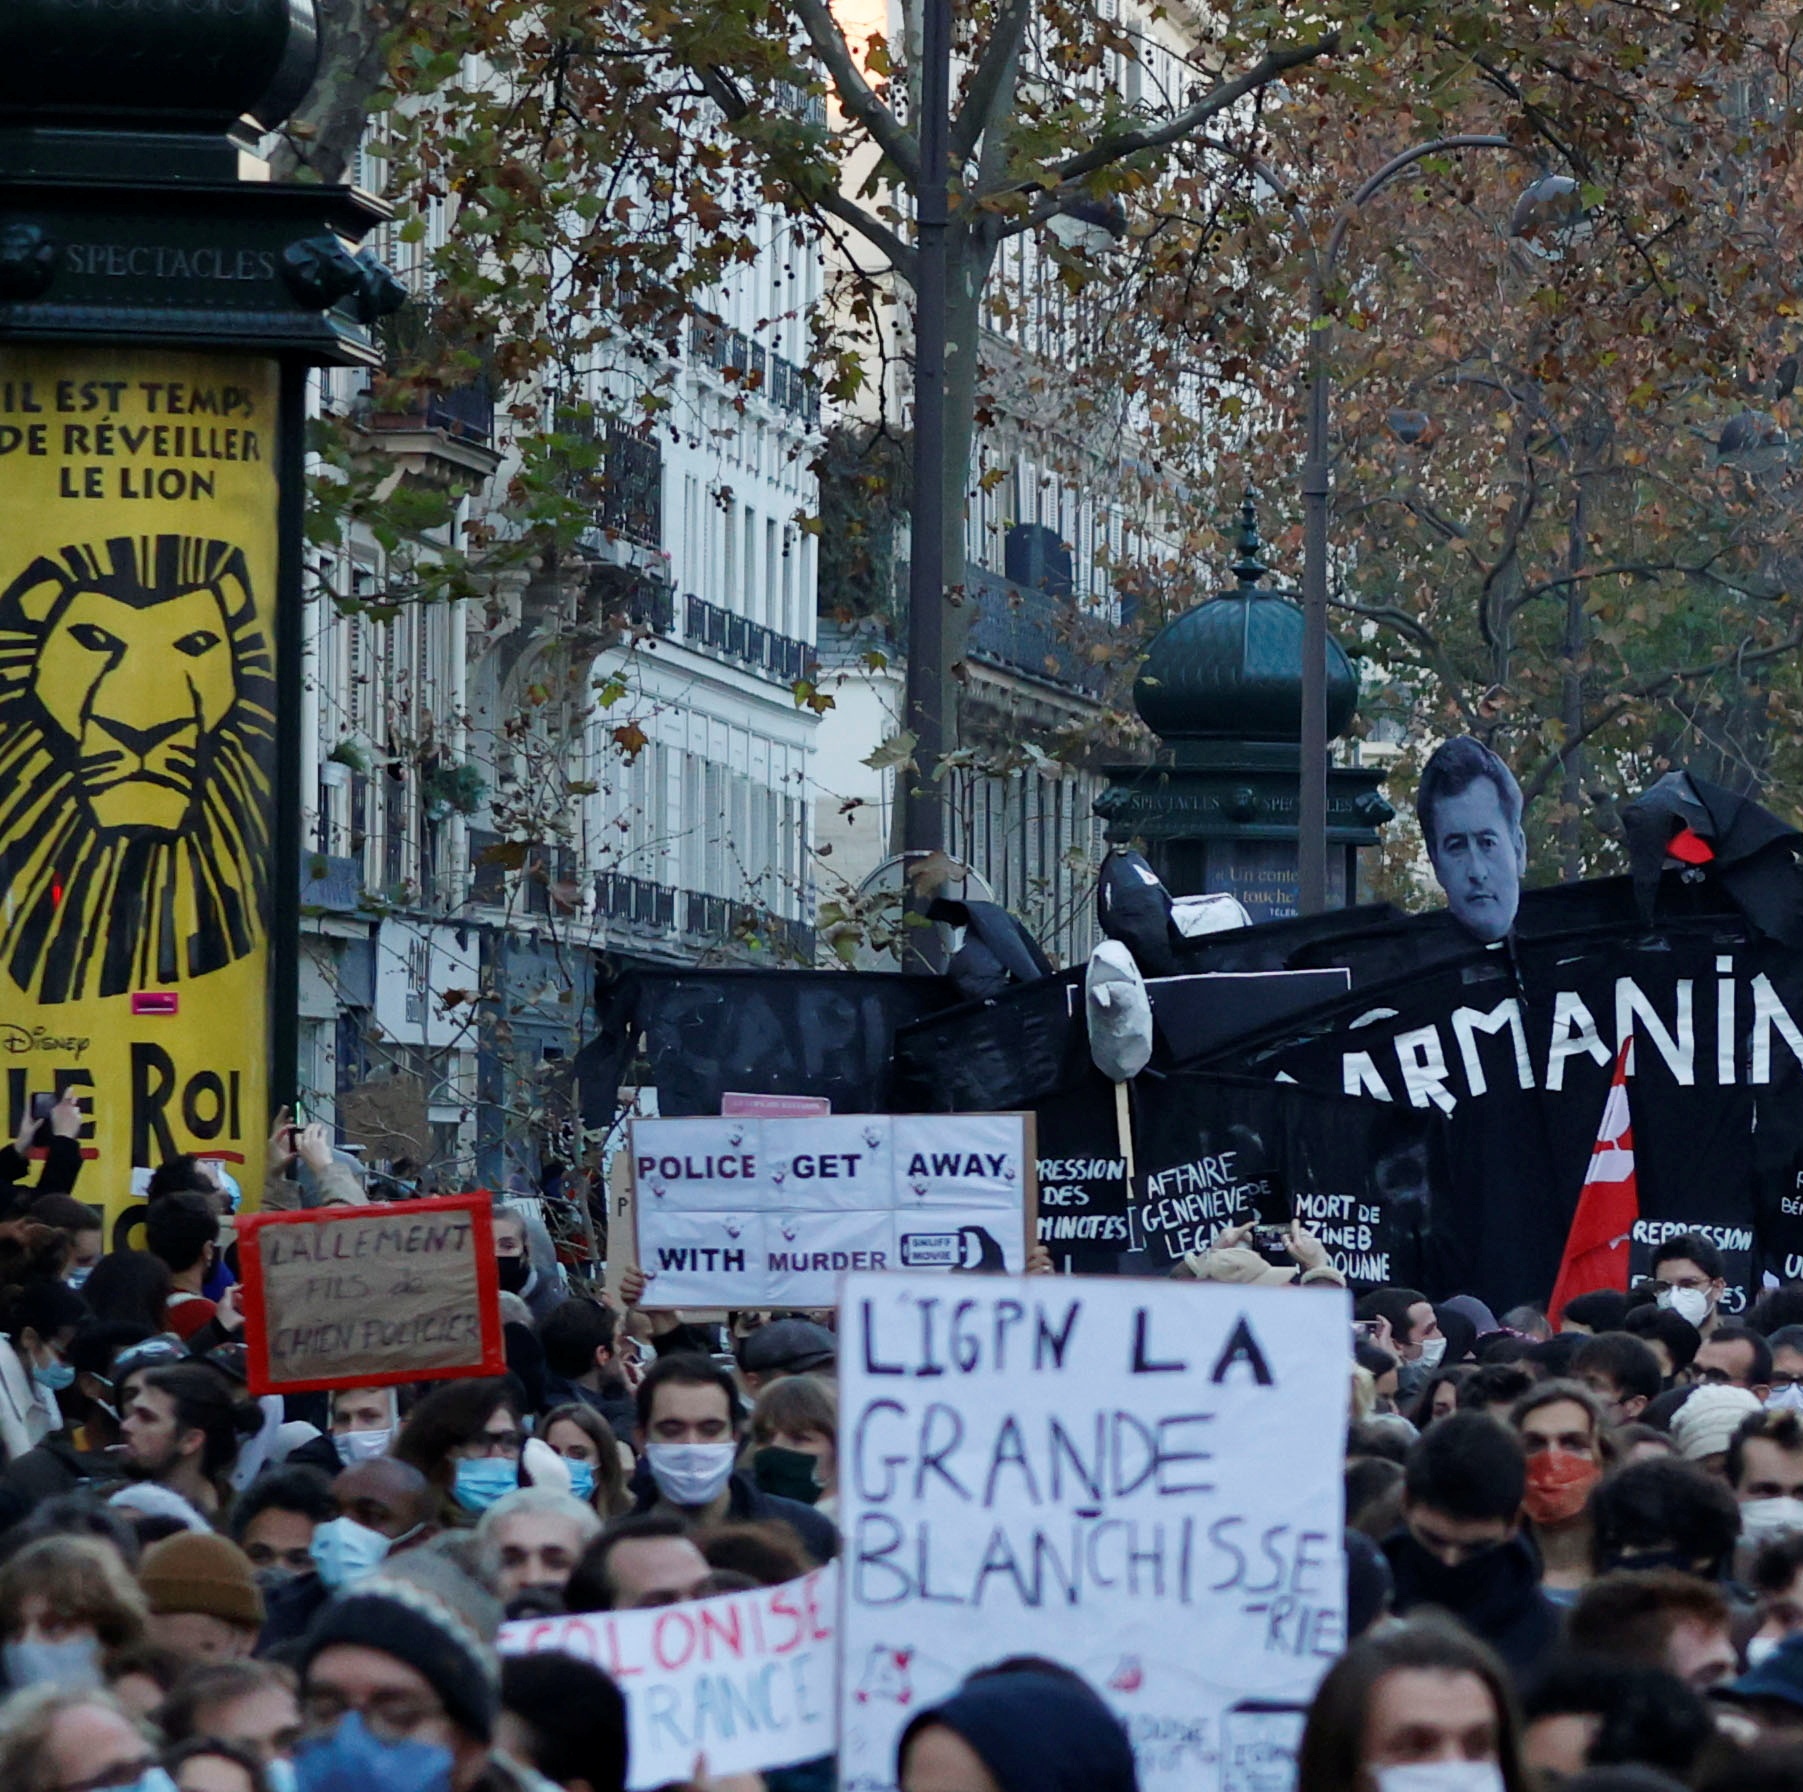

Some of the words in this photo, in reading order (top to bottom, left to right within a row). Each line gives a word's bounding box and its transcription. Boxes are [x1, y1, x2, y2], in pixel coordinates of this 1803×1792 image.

[66, 245, 274, 280] SPECTACLES
[4, 381, 43, 413] IL
[56, 381, 127, 413] EST
[139, 381, 255, 418] TEMPS
[0, 423, 48, 456] DE
[63, 416, 261, 462] RÉVEILLER
[60, 466, 104, 499] LE
[120, 467, 216, 500] LION
[1228, 866, 1255, 883] Un
[637, 1155, 756, 1180] POLICE
[792, 1154, 863, 1179] GET
[906, 1153, 1008, 1177] AWAY
[1034, 1158, 1126, 1181] RESSION
[1147, 1151, 1239, 1200] AFFAIRE
[1043, 1186, 1089, 1206] DES
[1141, 1186, 1249, 1232] GENEVIÈVE
[1296, 1194, 1355, 1219] MORT
[1358, 1205, 1381, 1224] DE
[270, 1223, 471, 1266] LALLEMENT
[658, 1248, 745, 1273] WITH
[768, 1251, 888, 1273] MURDER
[1326, 1252, 1391, 1283] DOUANE
[306, 1273, 371, 1300] FILS
[272, 1319, 353, 1359] CHIEN
[1130, 1306, 1276, 1388] LA
[852, 1398, 1217, 1509] GRANDE
[850, 1510, 1331, 1609] BLANCHISSE
[645, 1652, 820, 1750] RANCE
